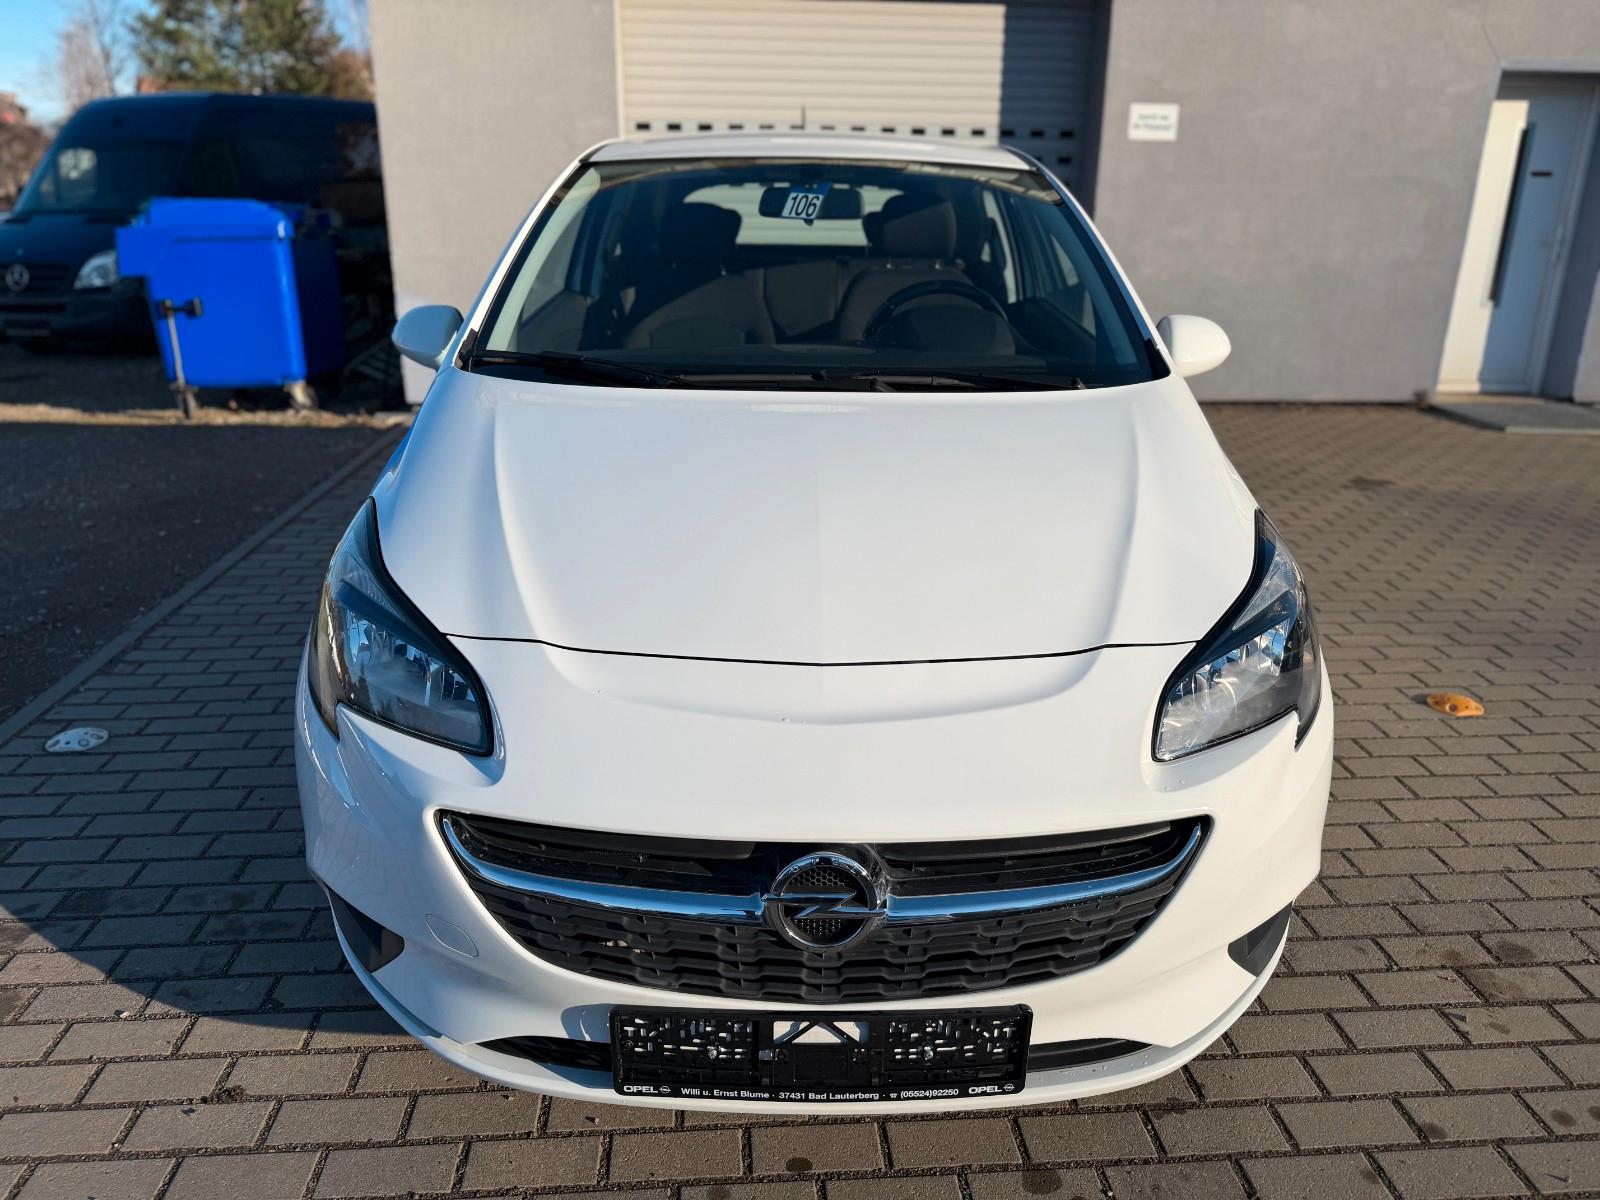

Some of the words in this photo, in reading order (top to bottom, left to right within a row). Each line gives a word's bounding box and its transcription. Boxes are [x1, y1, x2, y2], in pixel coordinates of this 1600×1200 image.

[788, 194, 820, 217] 106
[623, 1085, 659, 1094] OPEL
[680, 1087, 700, 1096] Willi
[702, 1089, 711, 1097] u.
[713, 1089, 738, 1098] Ernst
[740, 1090, 770, 1099] Blume
[778, 1092, 805, 1100] 37431
[808, 1092, 827, 1100] Bad
[829, 1091, 880, 1100] Lauterberg
[968, 1085, 1002, 1095] OPEL
